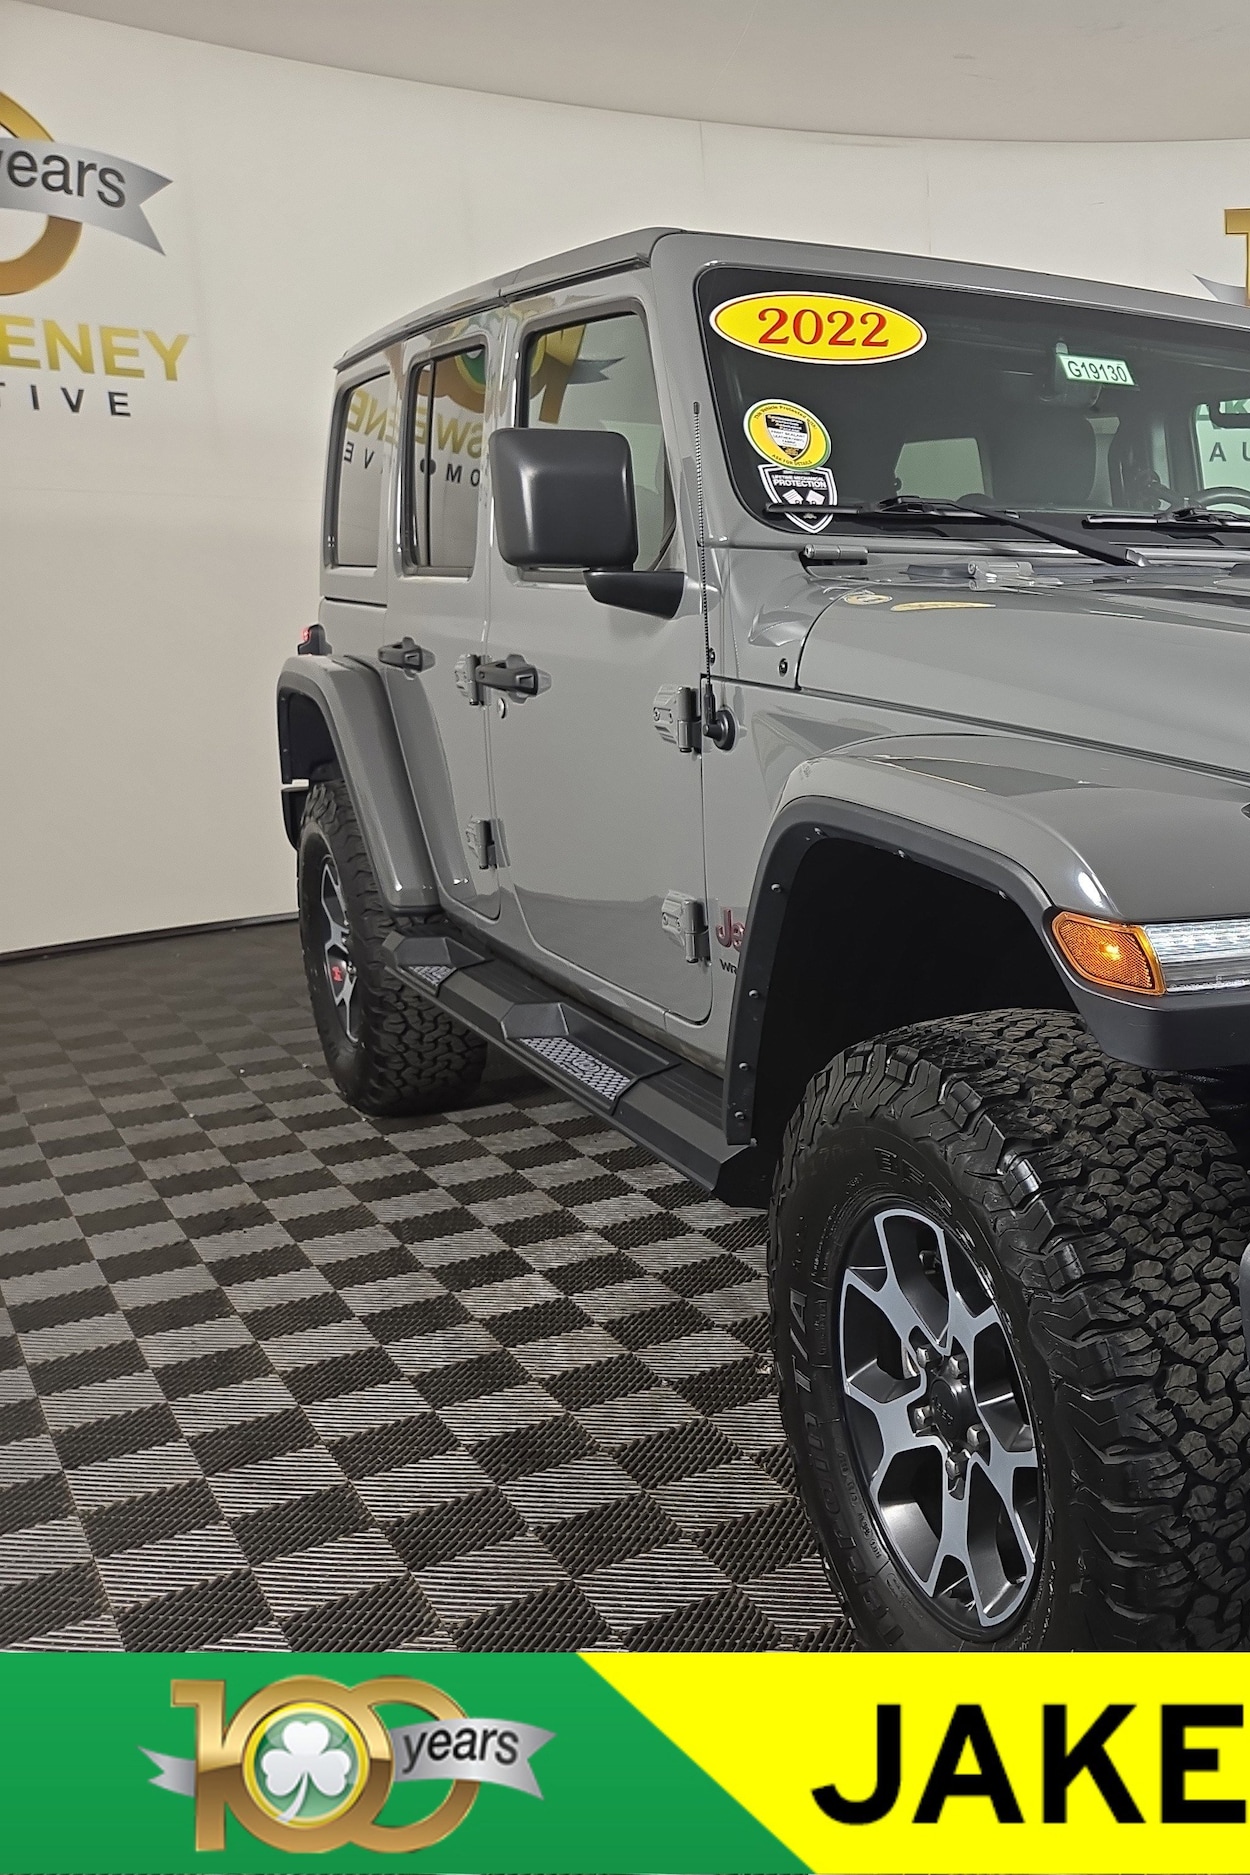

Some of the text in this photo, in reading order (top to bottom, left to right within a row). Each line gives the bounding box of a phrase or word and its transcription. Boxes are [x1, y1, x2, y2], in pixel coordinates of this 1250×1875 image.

[0, 148, 126, 208] ears
[0, 314, 190, 382] ENEY
[757, 307, 889, 348] 2022
[1067, 360, 1128, 383] G19130
[0, 381, 131, 417] IVE
[773, 479, 827, 488] PROTECTION
[715, 908, 746, 952] Je
